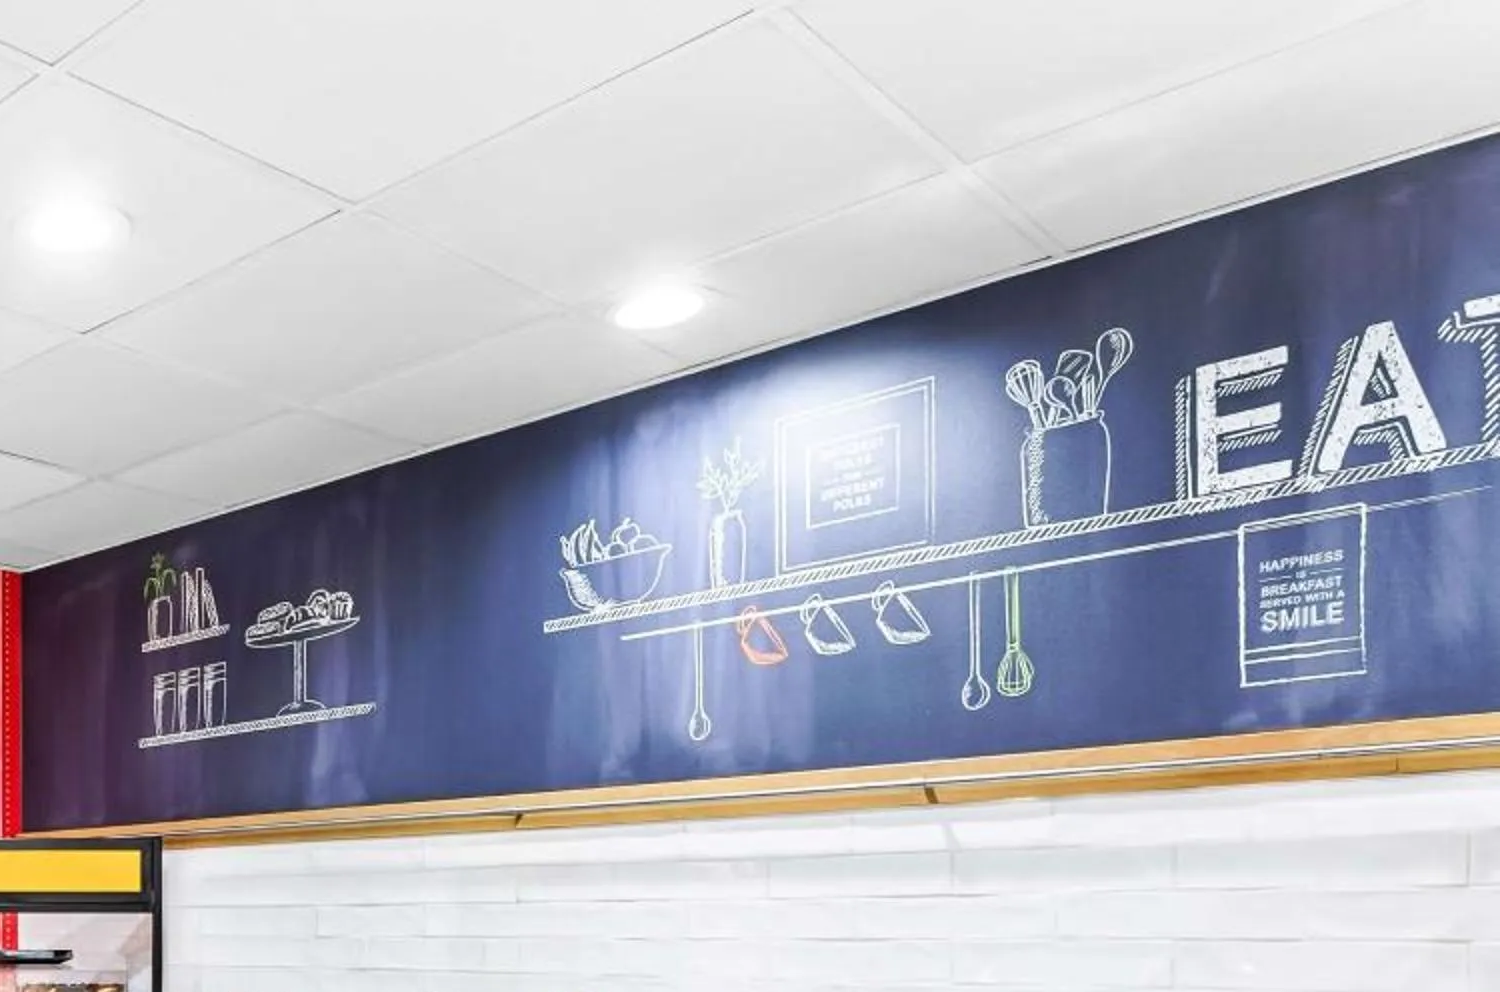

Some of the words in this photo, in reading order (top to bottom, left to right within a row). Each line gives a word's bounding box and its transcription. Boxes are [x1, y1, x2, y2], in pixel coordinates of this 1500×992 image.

[1260, 549, 1345, 573] HAPPINESS
[1261, 575, 1342, 599] BREAKFAST
[1305, 591, 1333, 603] WITH
[1336, 589, 1345, 599] A
[1260, 601, 1345, 633] SMILE
